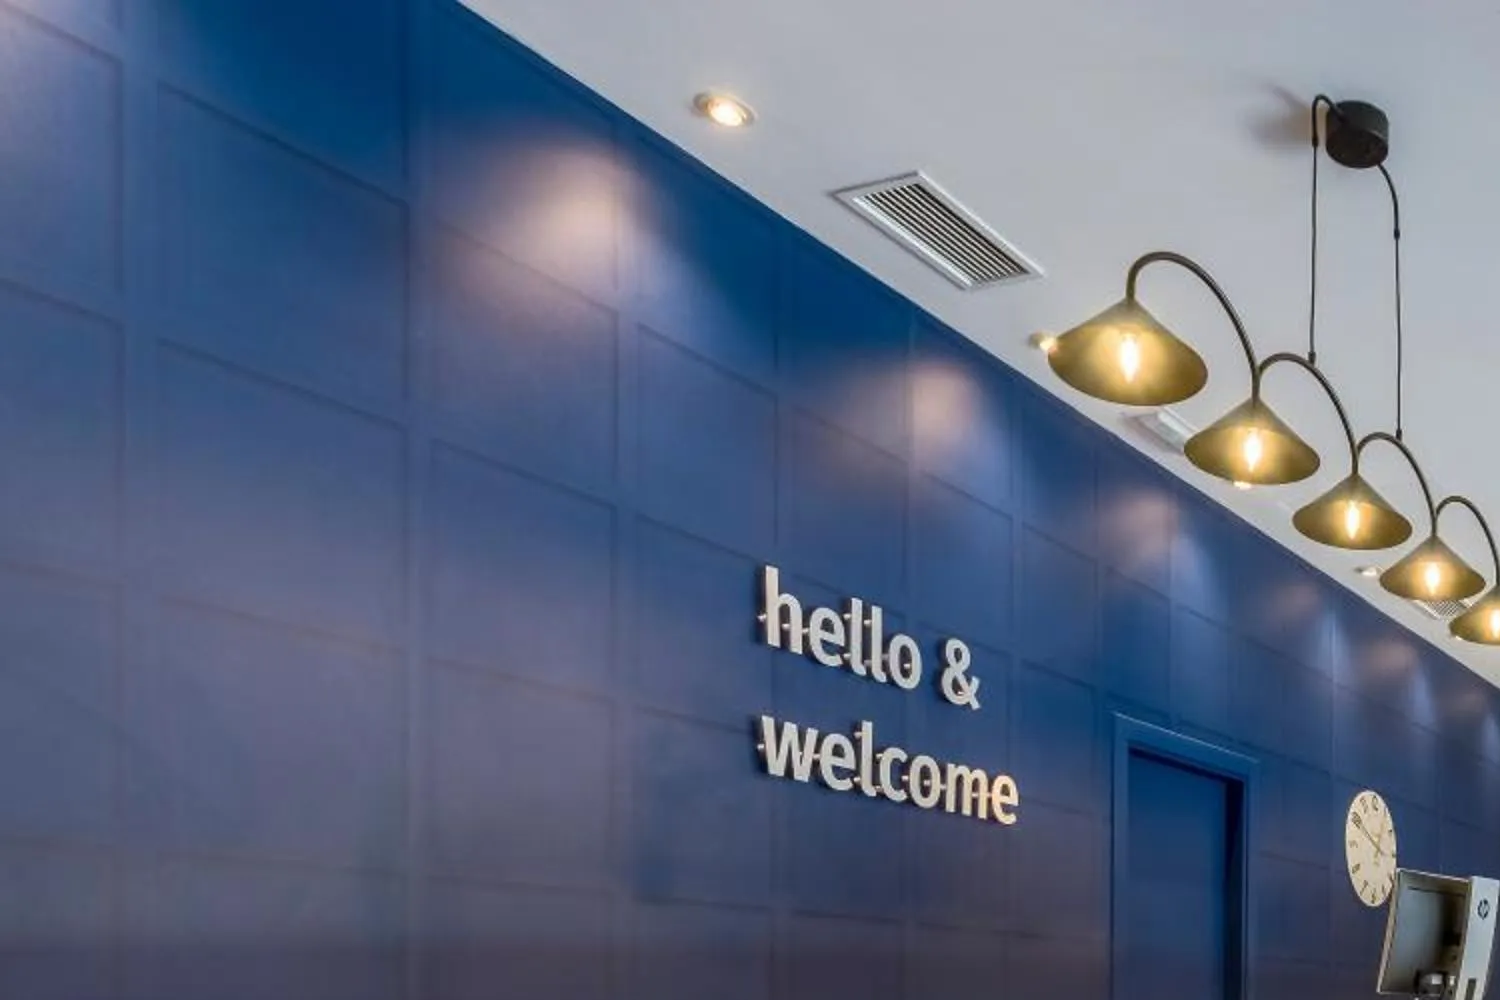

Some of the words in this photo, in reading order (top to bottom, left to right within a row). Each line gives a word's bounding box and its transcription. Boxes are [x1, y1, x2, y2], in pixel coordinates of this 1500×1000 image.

[765, 564, 923, 690] hello
[940, 638, 980, 710] &
[761, 715, 1020, 825] welcome
